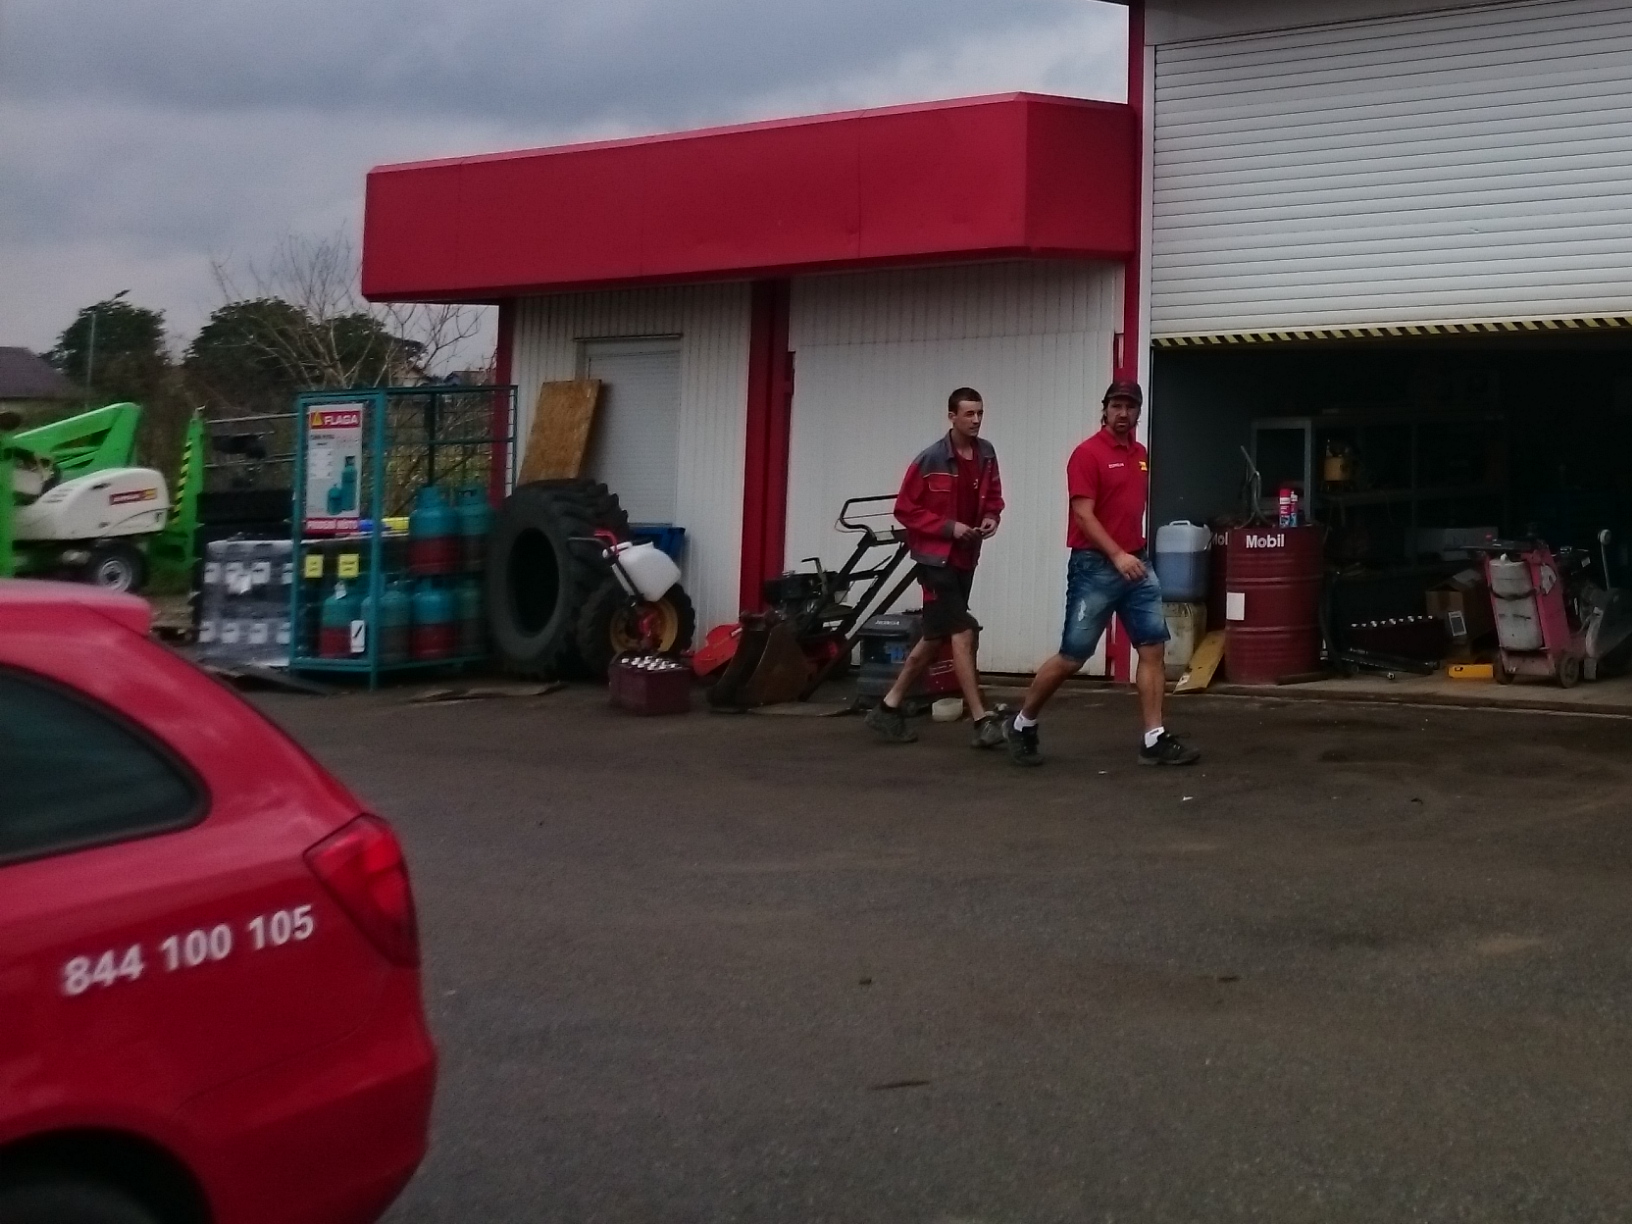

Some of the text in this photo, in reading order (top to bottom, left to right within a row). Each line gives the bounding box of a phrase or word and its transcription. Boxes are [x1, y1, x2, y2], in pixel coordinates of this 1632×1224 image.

[324, 414, 358, 425] FLAGA
[1245, 533, 1285, 549] Mobil
[61, 904, 315, 996] 844 100 105
